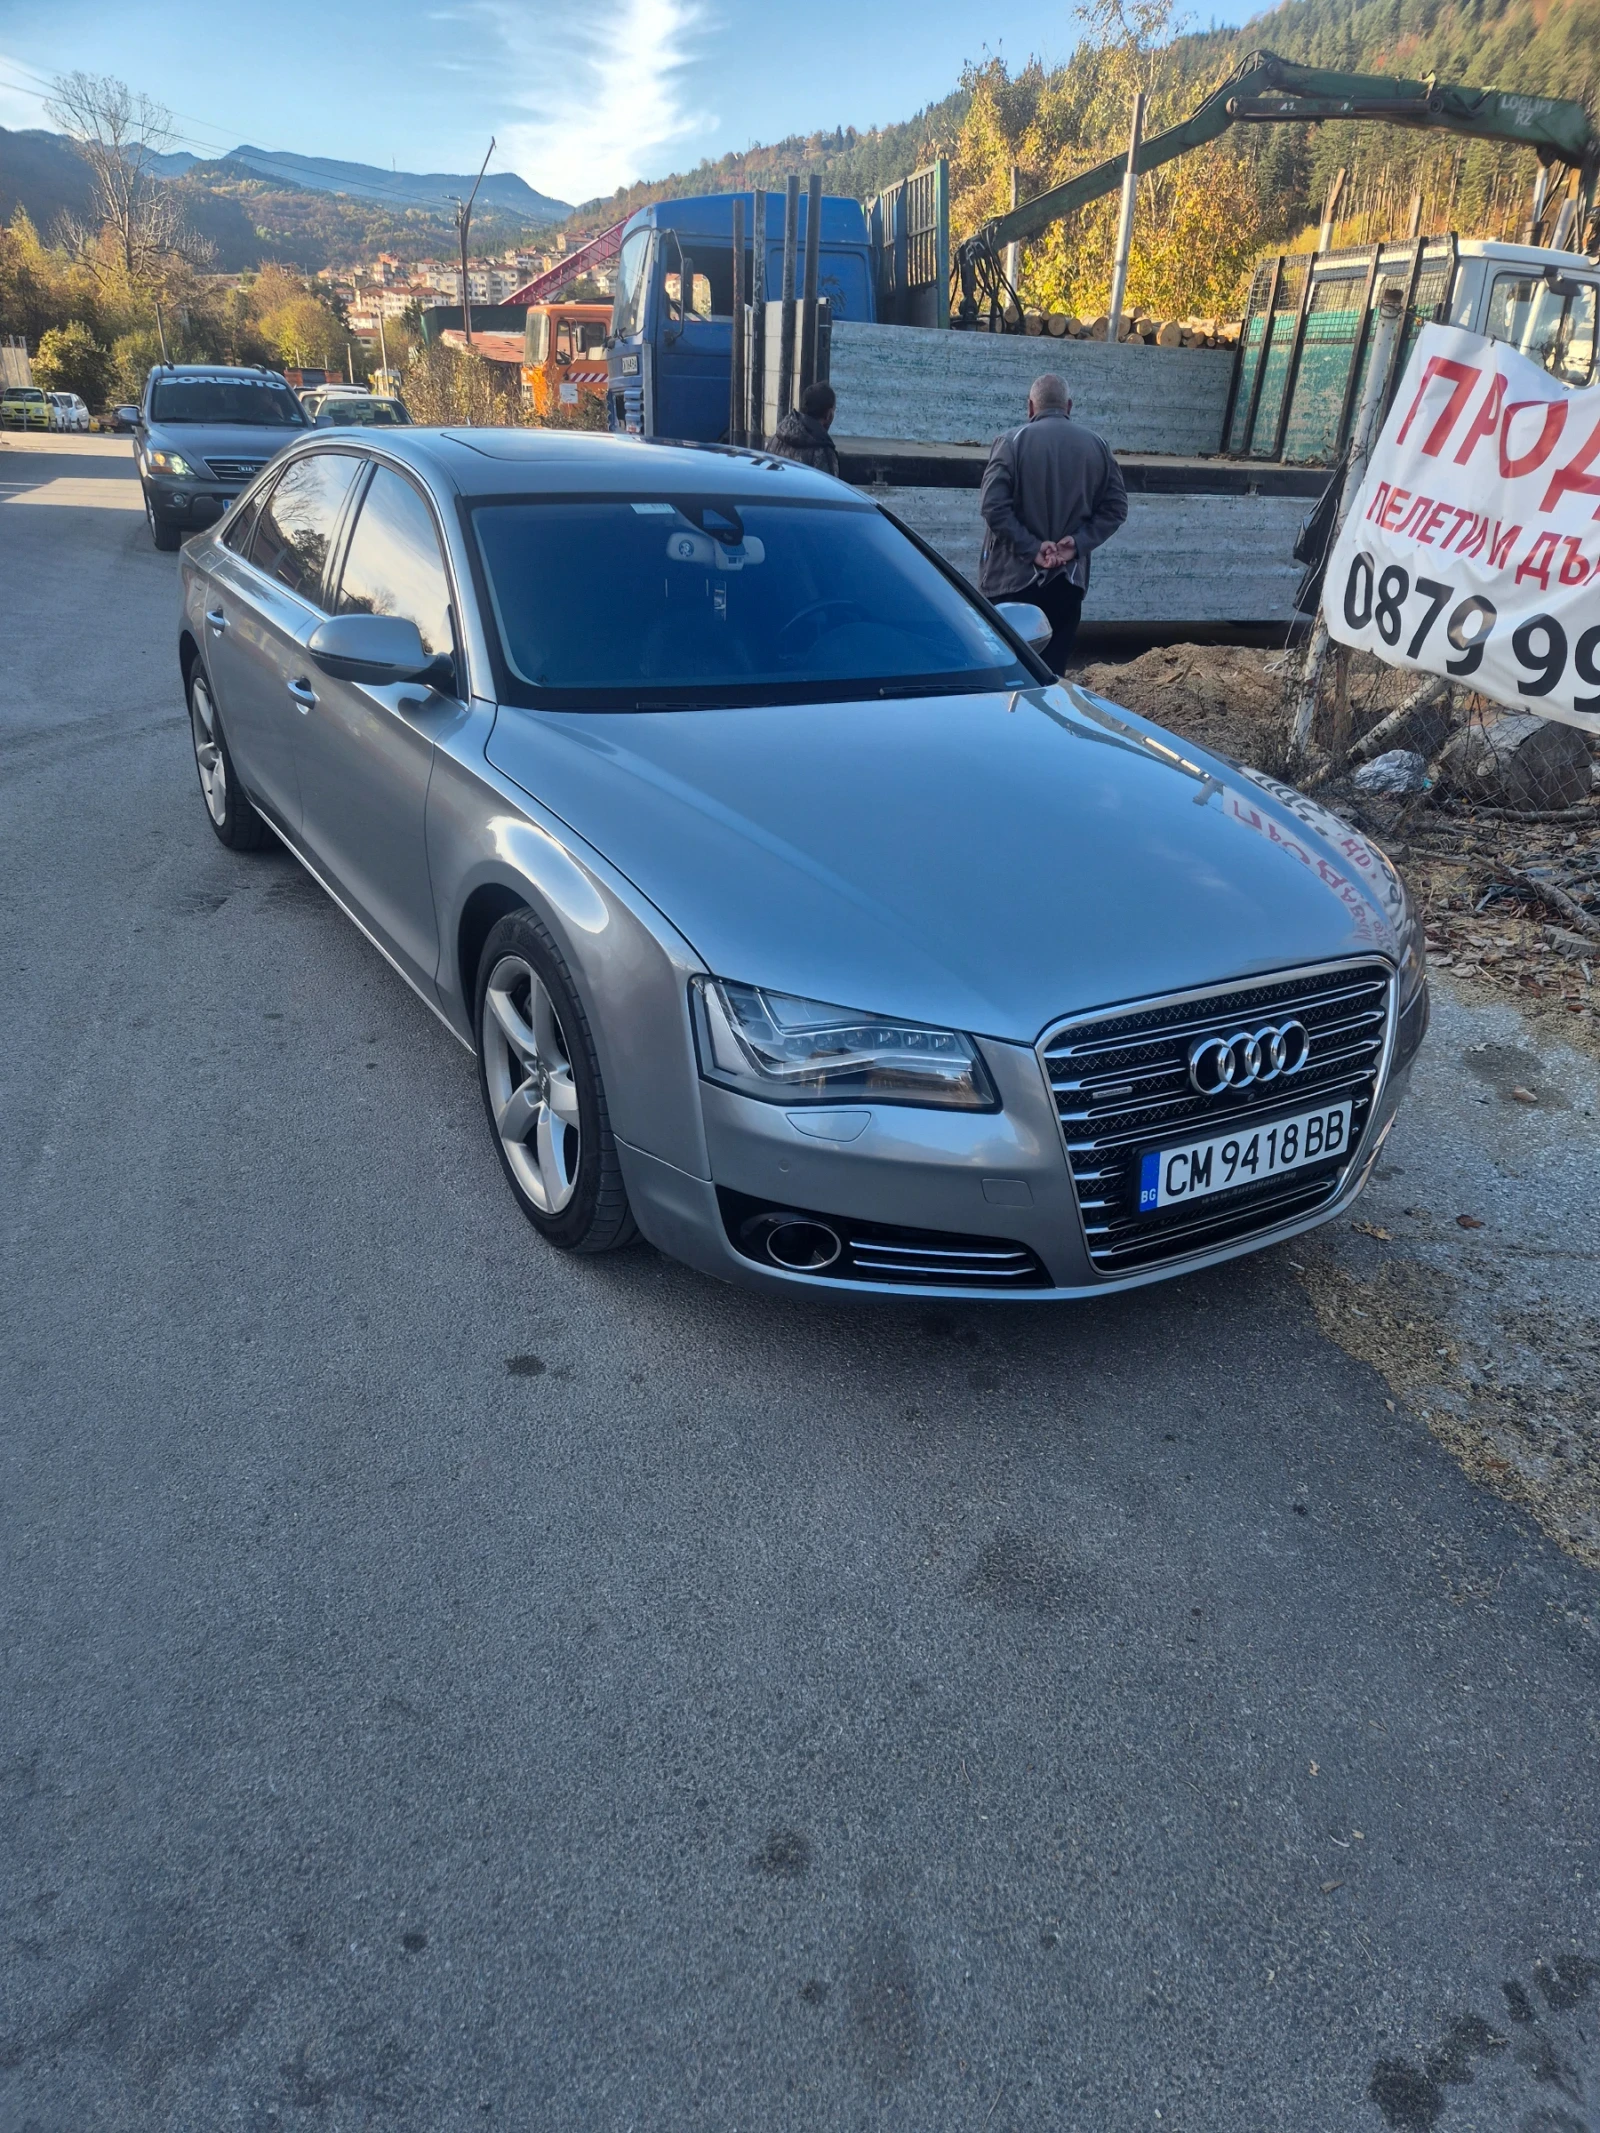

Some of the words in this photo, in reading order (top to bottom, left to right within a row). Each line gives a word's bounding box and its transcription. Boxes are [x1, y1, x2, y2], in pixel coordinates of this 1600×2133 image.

[156, 377, 286, 390] SORENTO
[1343, 551, 1497, 677] 0879
[1141, 1188, 1157, 1204] BG
